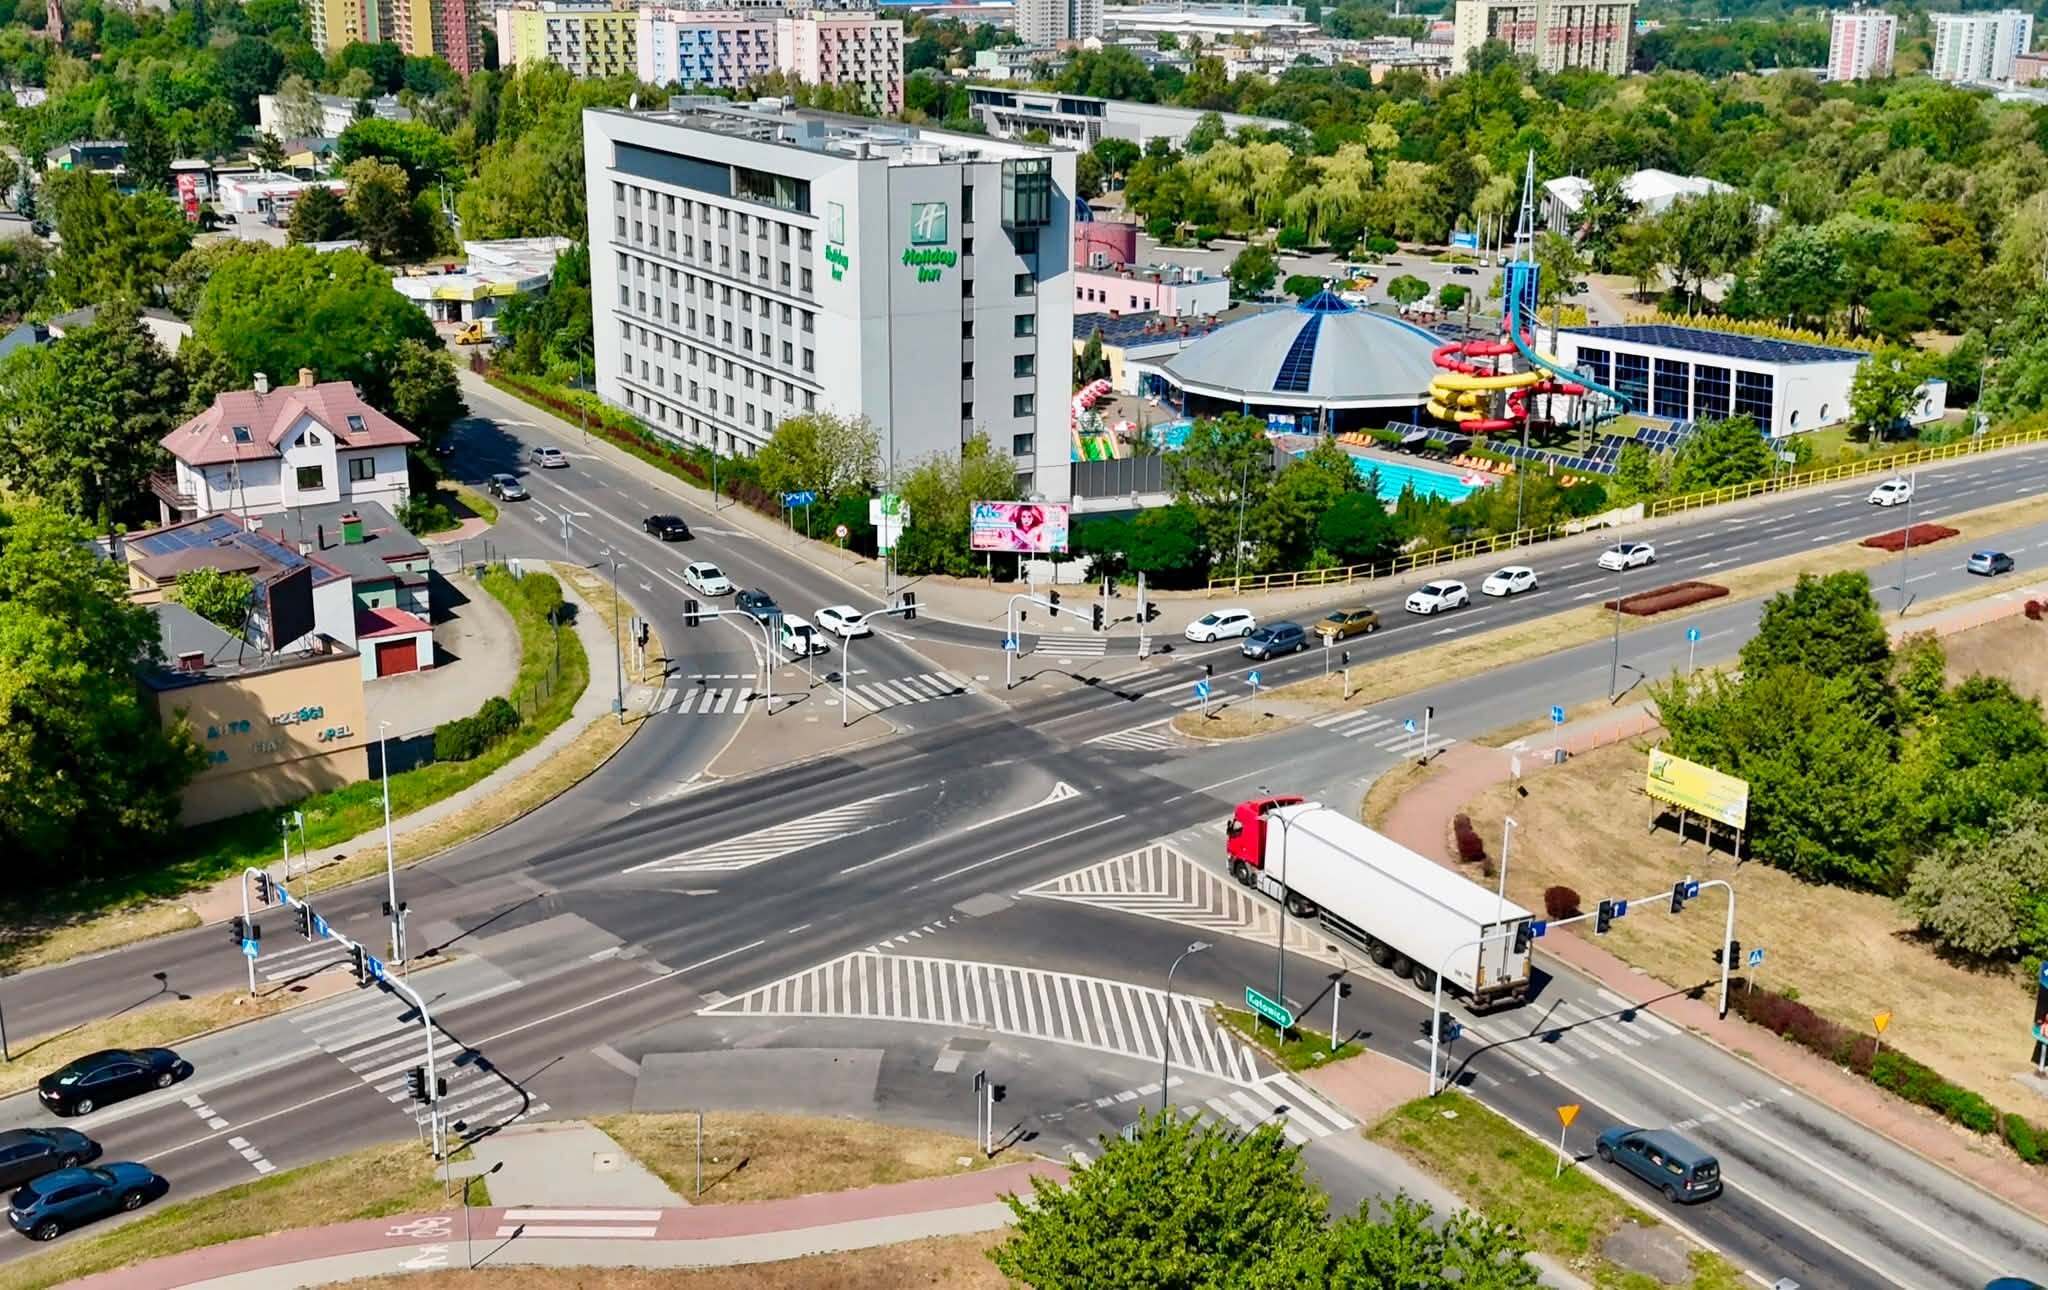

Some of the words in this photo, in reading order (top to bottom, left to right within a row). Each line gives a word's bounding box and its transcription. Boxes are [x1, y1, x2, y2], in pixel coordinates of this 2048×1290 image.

[902, 247, 957, 268] Holiday
[917, 266, 942, 283] Inn
[207, 719, 251, 739] AUTO
[315, 725, 354, 743] OPEL
[1248, 992, 1287, 1023] Katowice
